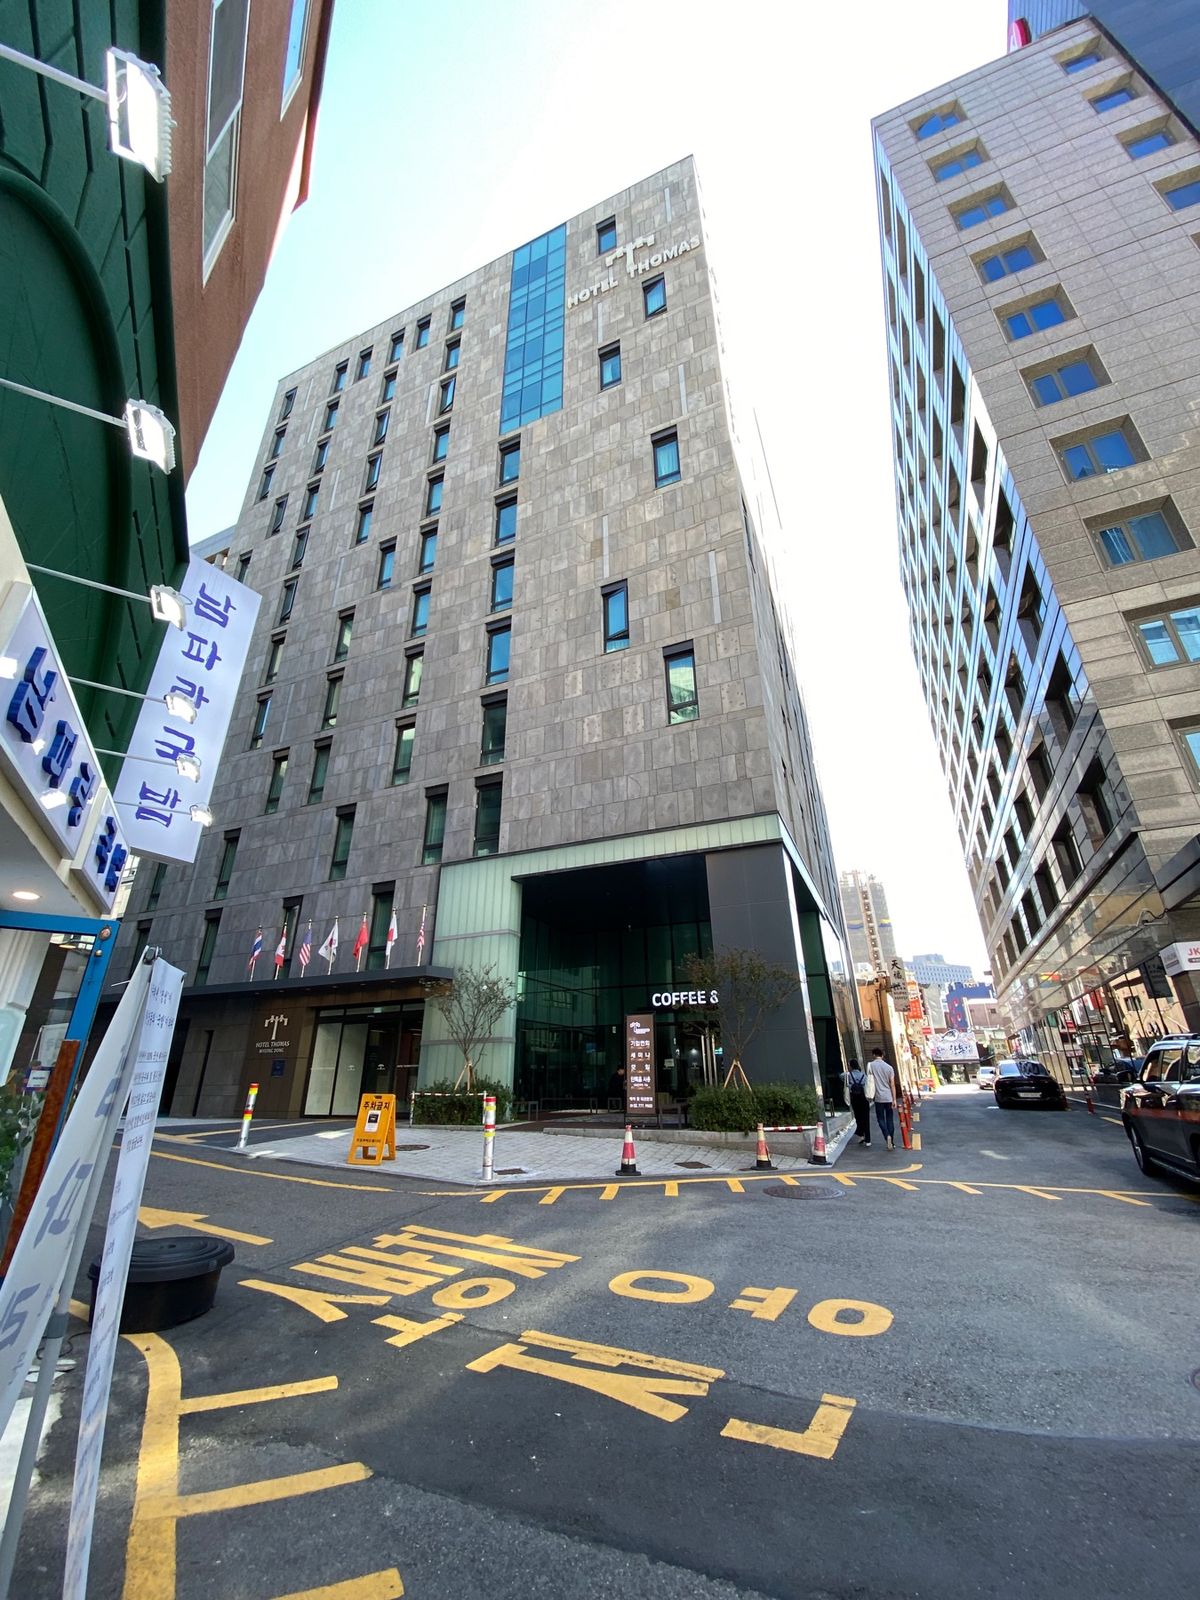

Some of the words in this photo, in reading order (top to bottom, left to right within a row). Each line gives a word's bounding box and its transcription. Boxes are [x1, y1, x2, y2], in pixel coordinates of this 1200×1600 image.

[567, 276, 619, 309] HOTEL
[627, 235, 701, 278] THOMAS
[652, 991, 706, 1006] COFFEE
[710, 990, 719, 1004] &
[363, 1101, 390, 1111] 주차금지
[465, 1269, 894, 1459] 전용
